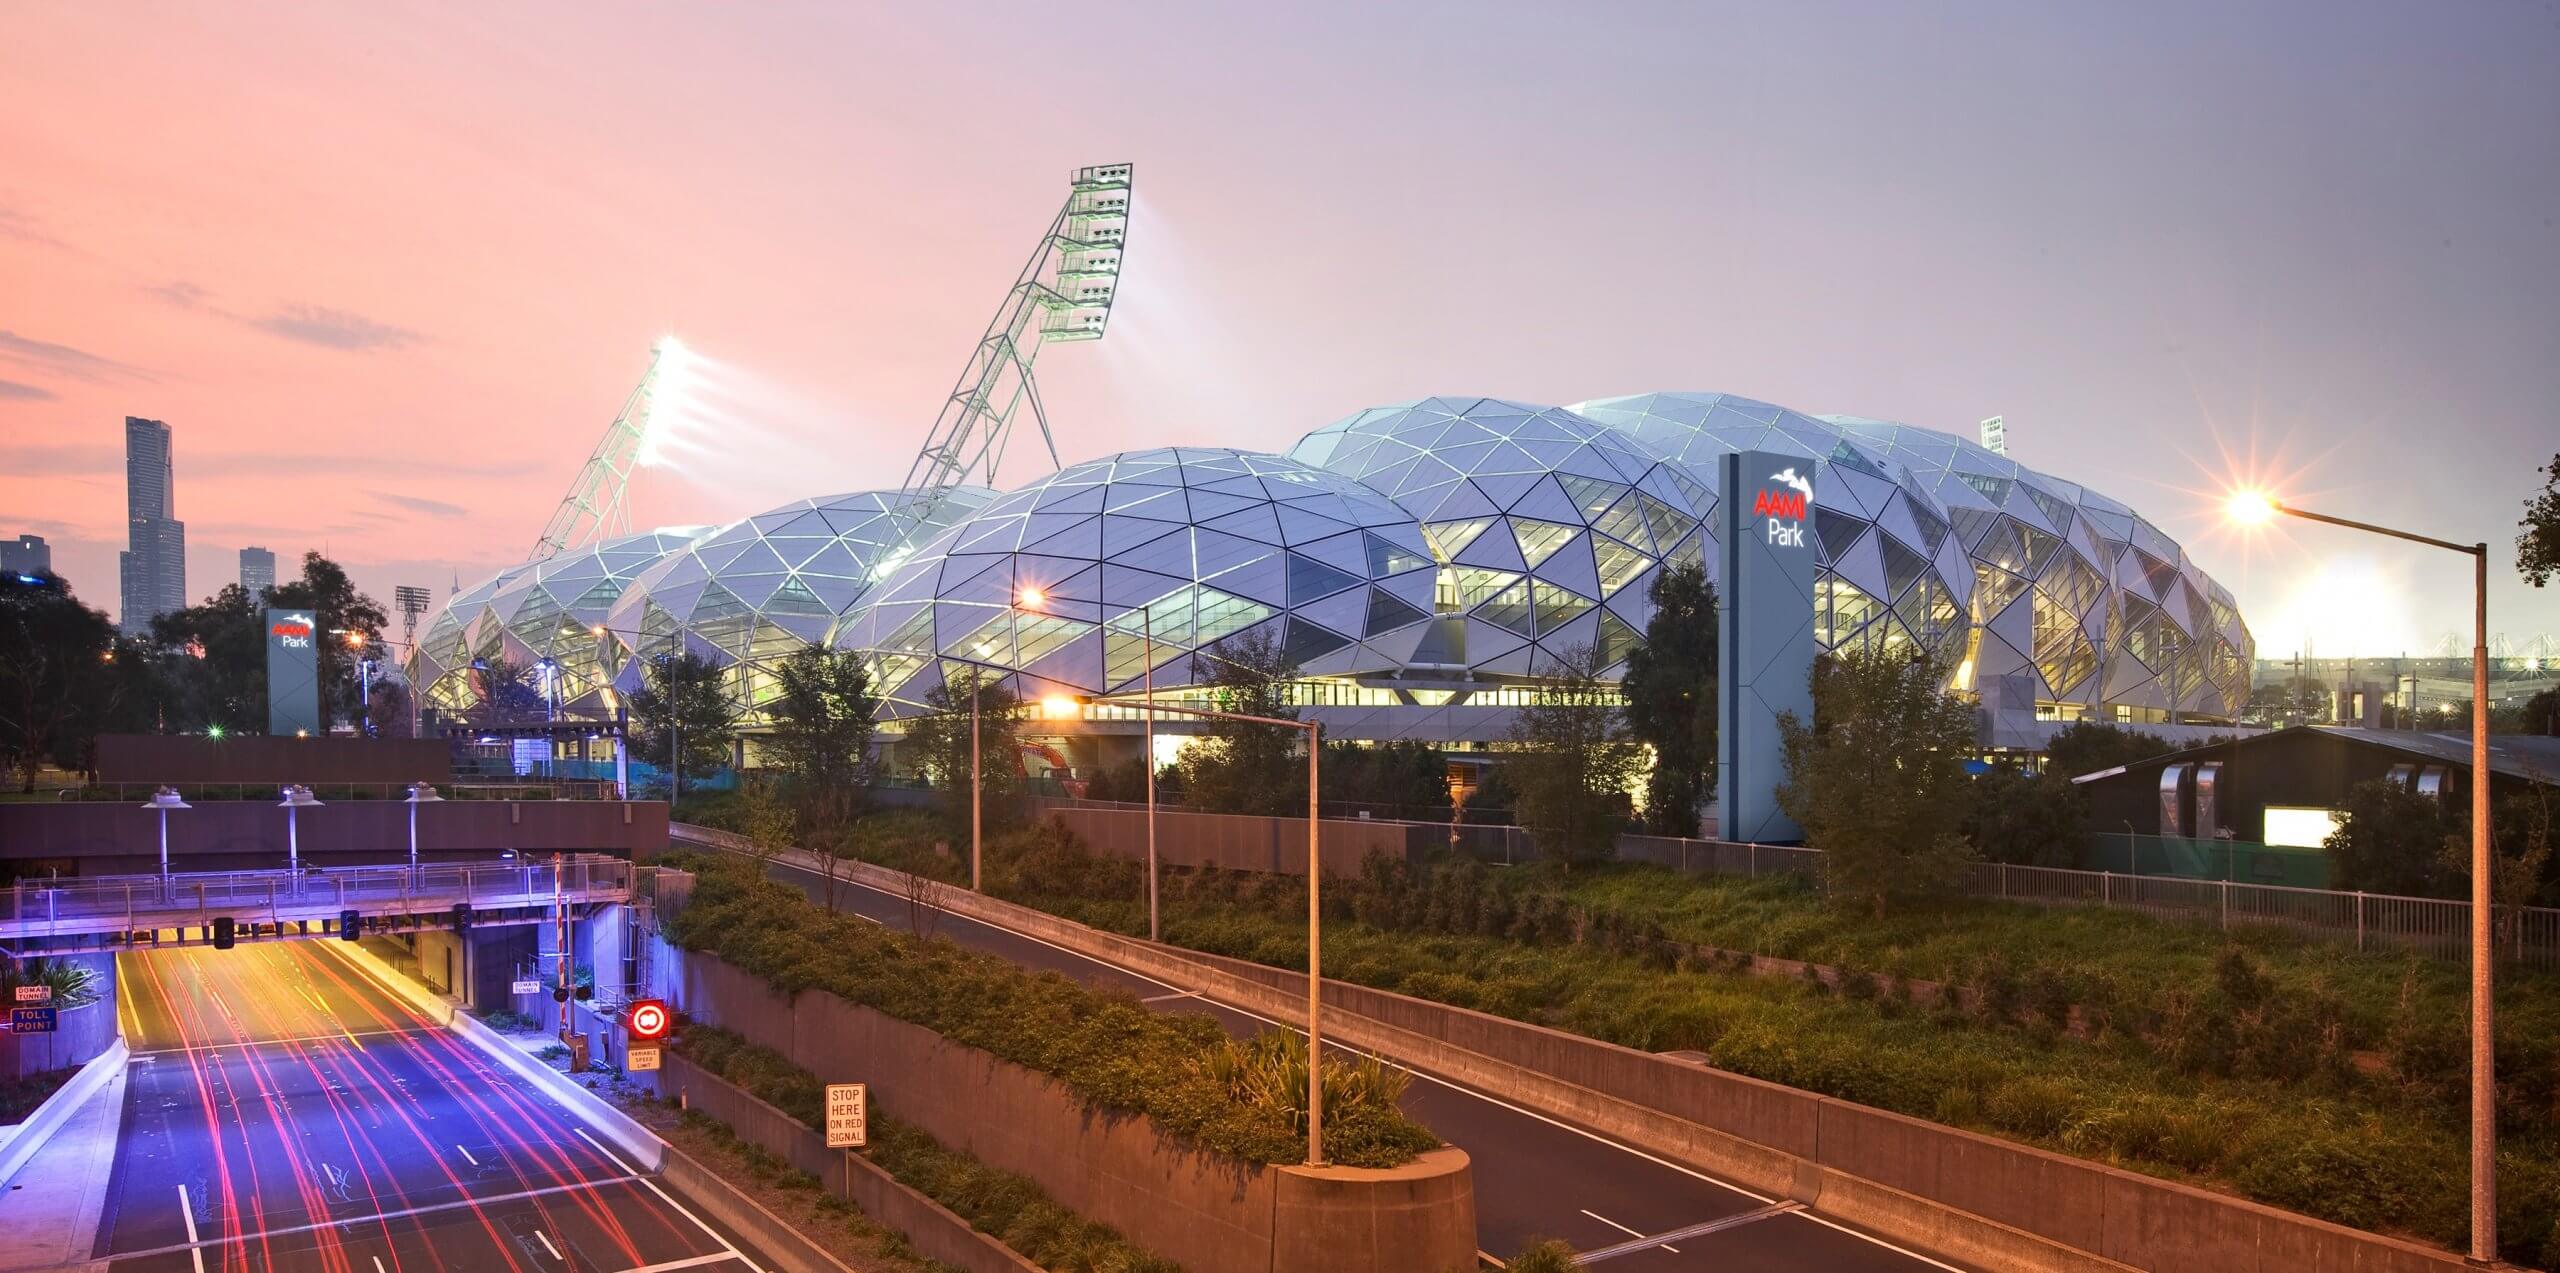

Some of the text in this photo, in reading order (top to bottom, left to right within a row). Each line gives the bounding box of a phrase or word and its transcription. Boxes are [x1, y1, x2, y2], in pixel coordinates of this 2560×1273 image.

[1753, 490, 1806, 522] AAMI
[1769, 518, 1804, 548] Park
[271, 623, 309, 638] AAMI
[282, 635, 309, 648] Park
[18, 986, 49, 994] DOMAIN
[20, 1010, 49, 1020] TOLL
[16, 1021, 53, 1031] POINT
[832, 1089, 860, 1101] STOP
[832, 1104, 860, 1116] HERE
[830, 1118, 863, 1129] ON RED
[830, 1132, 863, 1143] SIGNAL
